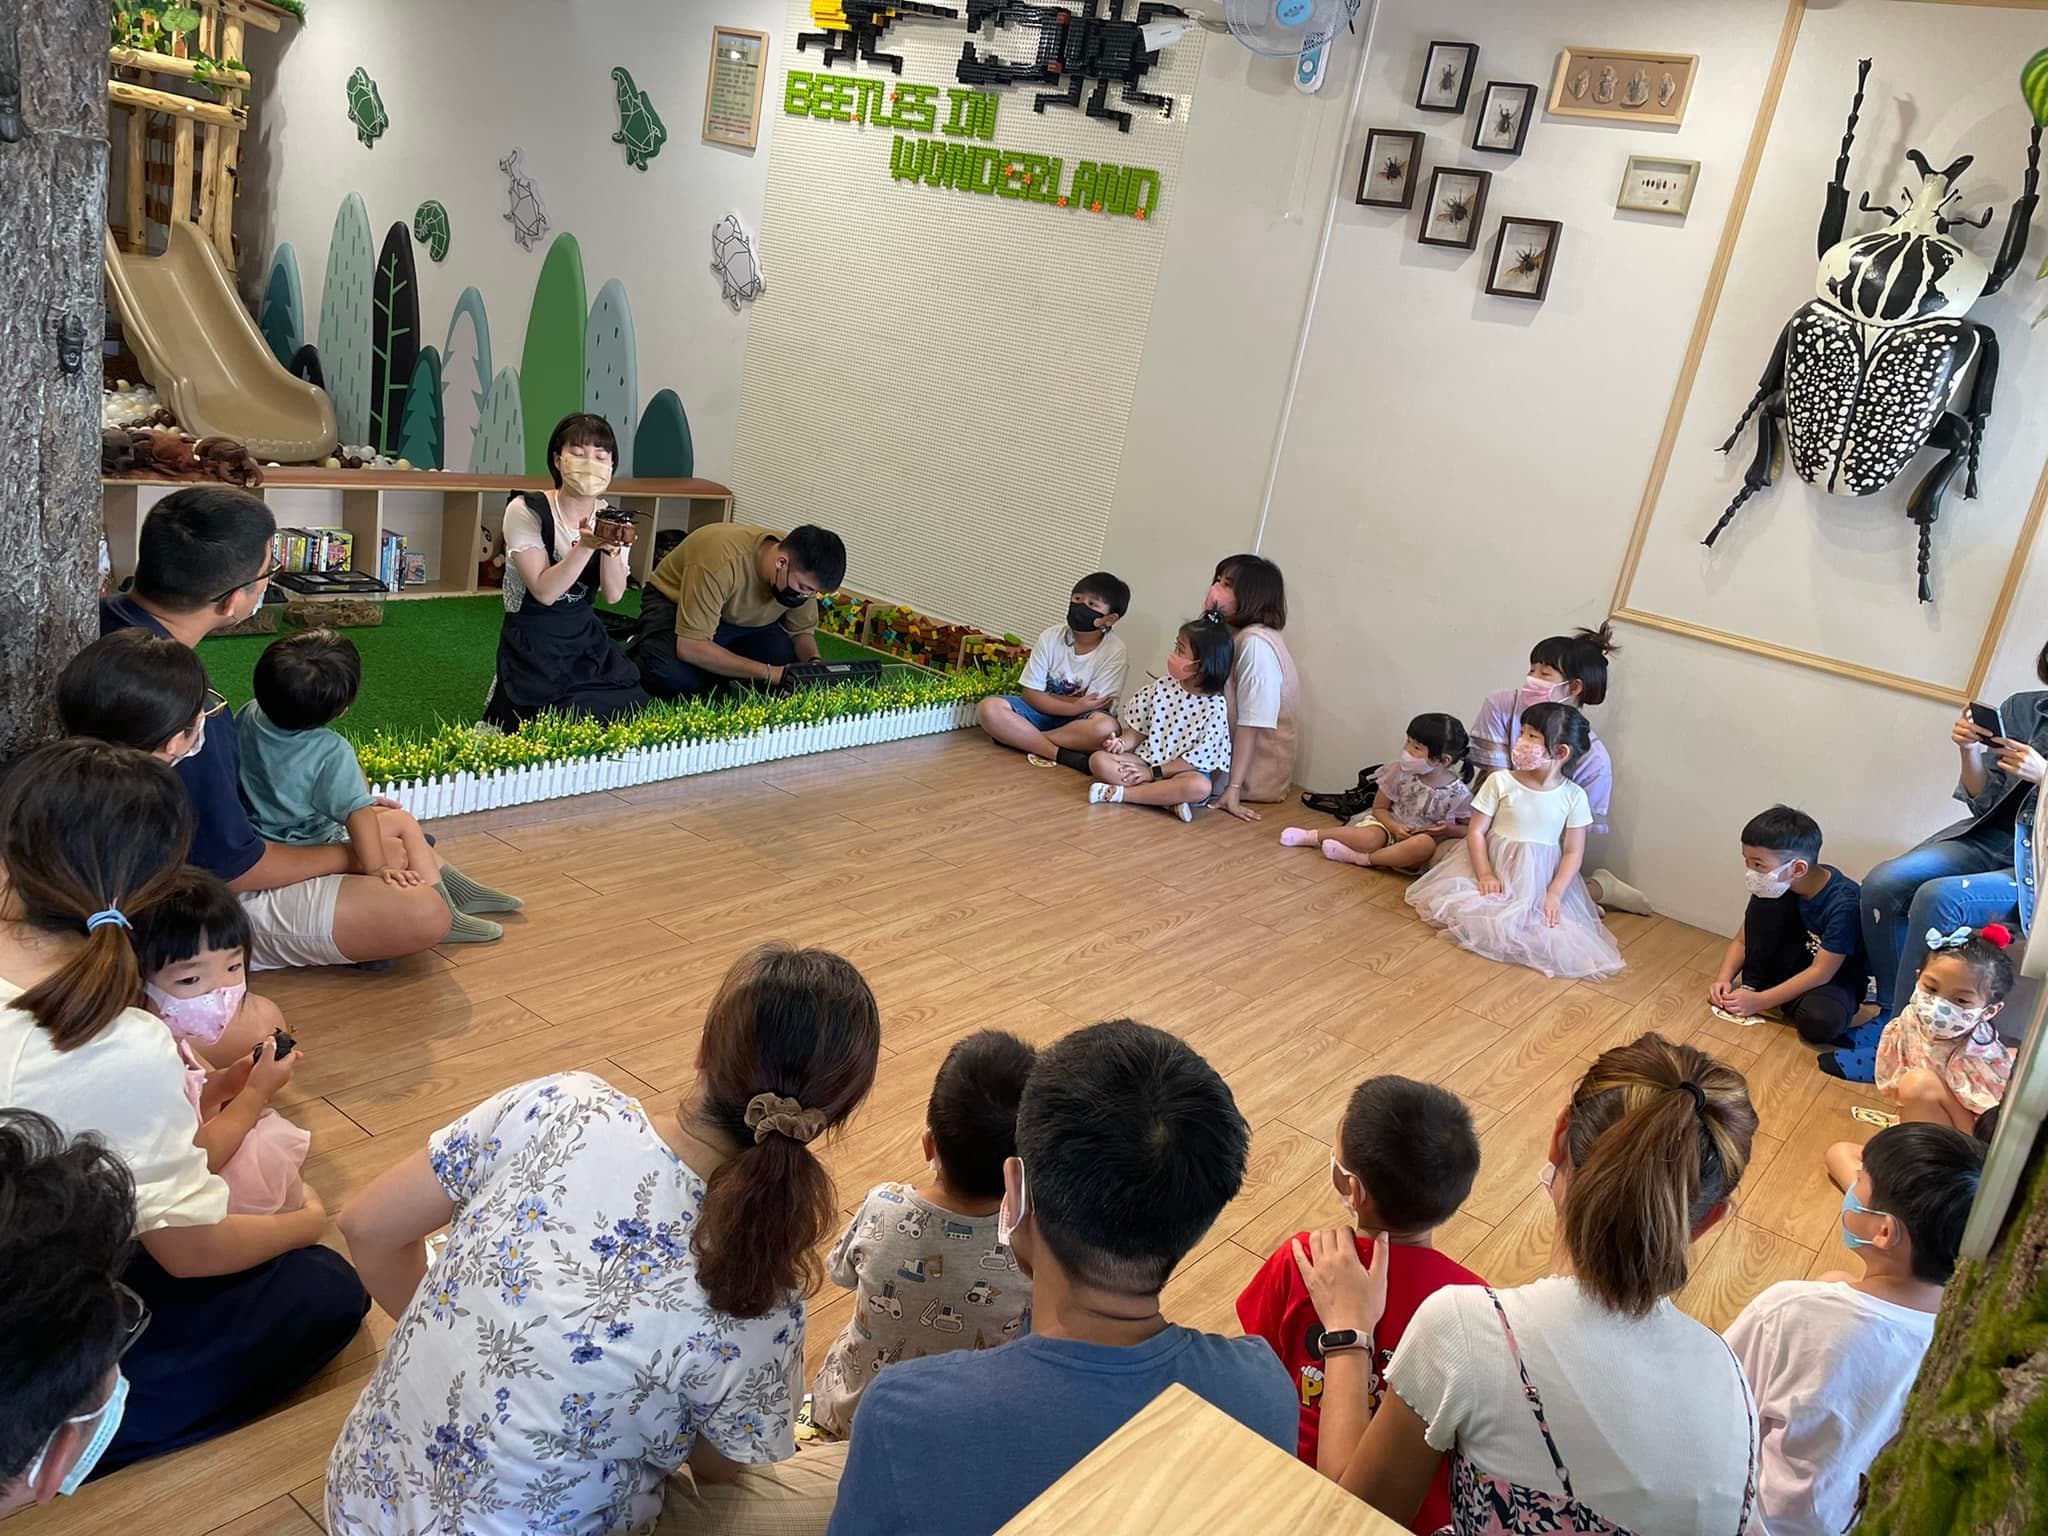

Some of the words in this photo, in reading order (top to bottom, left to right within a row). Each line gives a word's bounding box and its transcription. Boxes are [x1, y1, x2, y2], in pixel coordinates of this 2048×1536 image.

[785, 70, 939, 132] BEETLES
[942, 88, 999, 140] IN
[889, 135, 1161, 219] WONDERLAND
